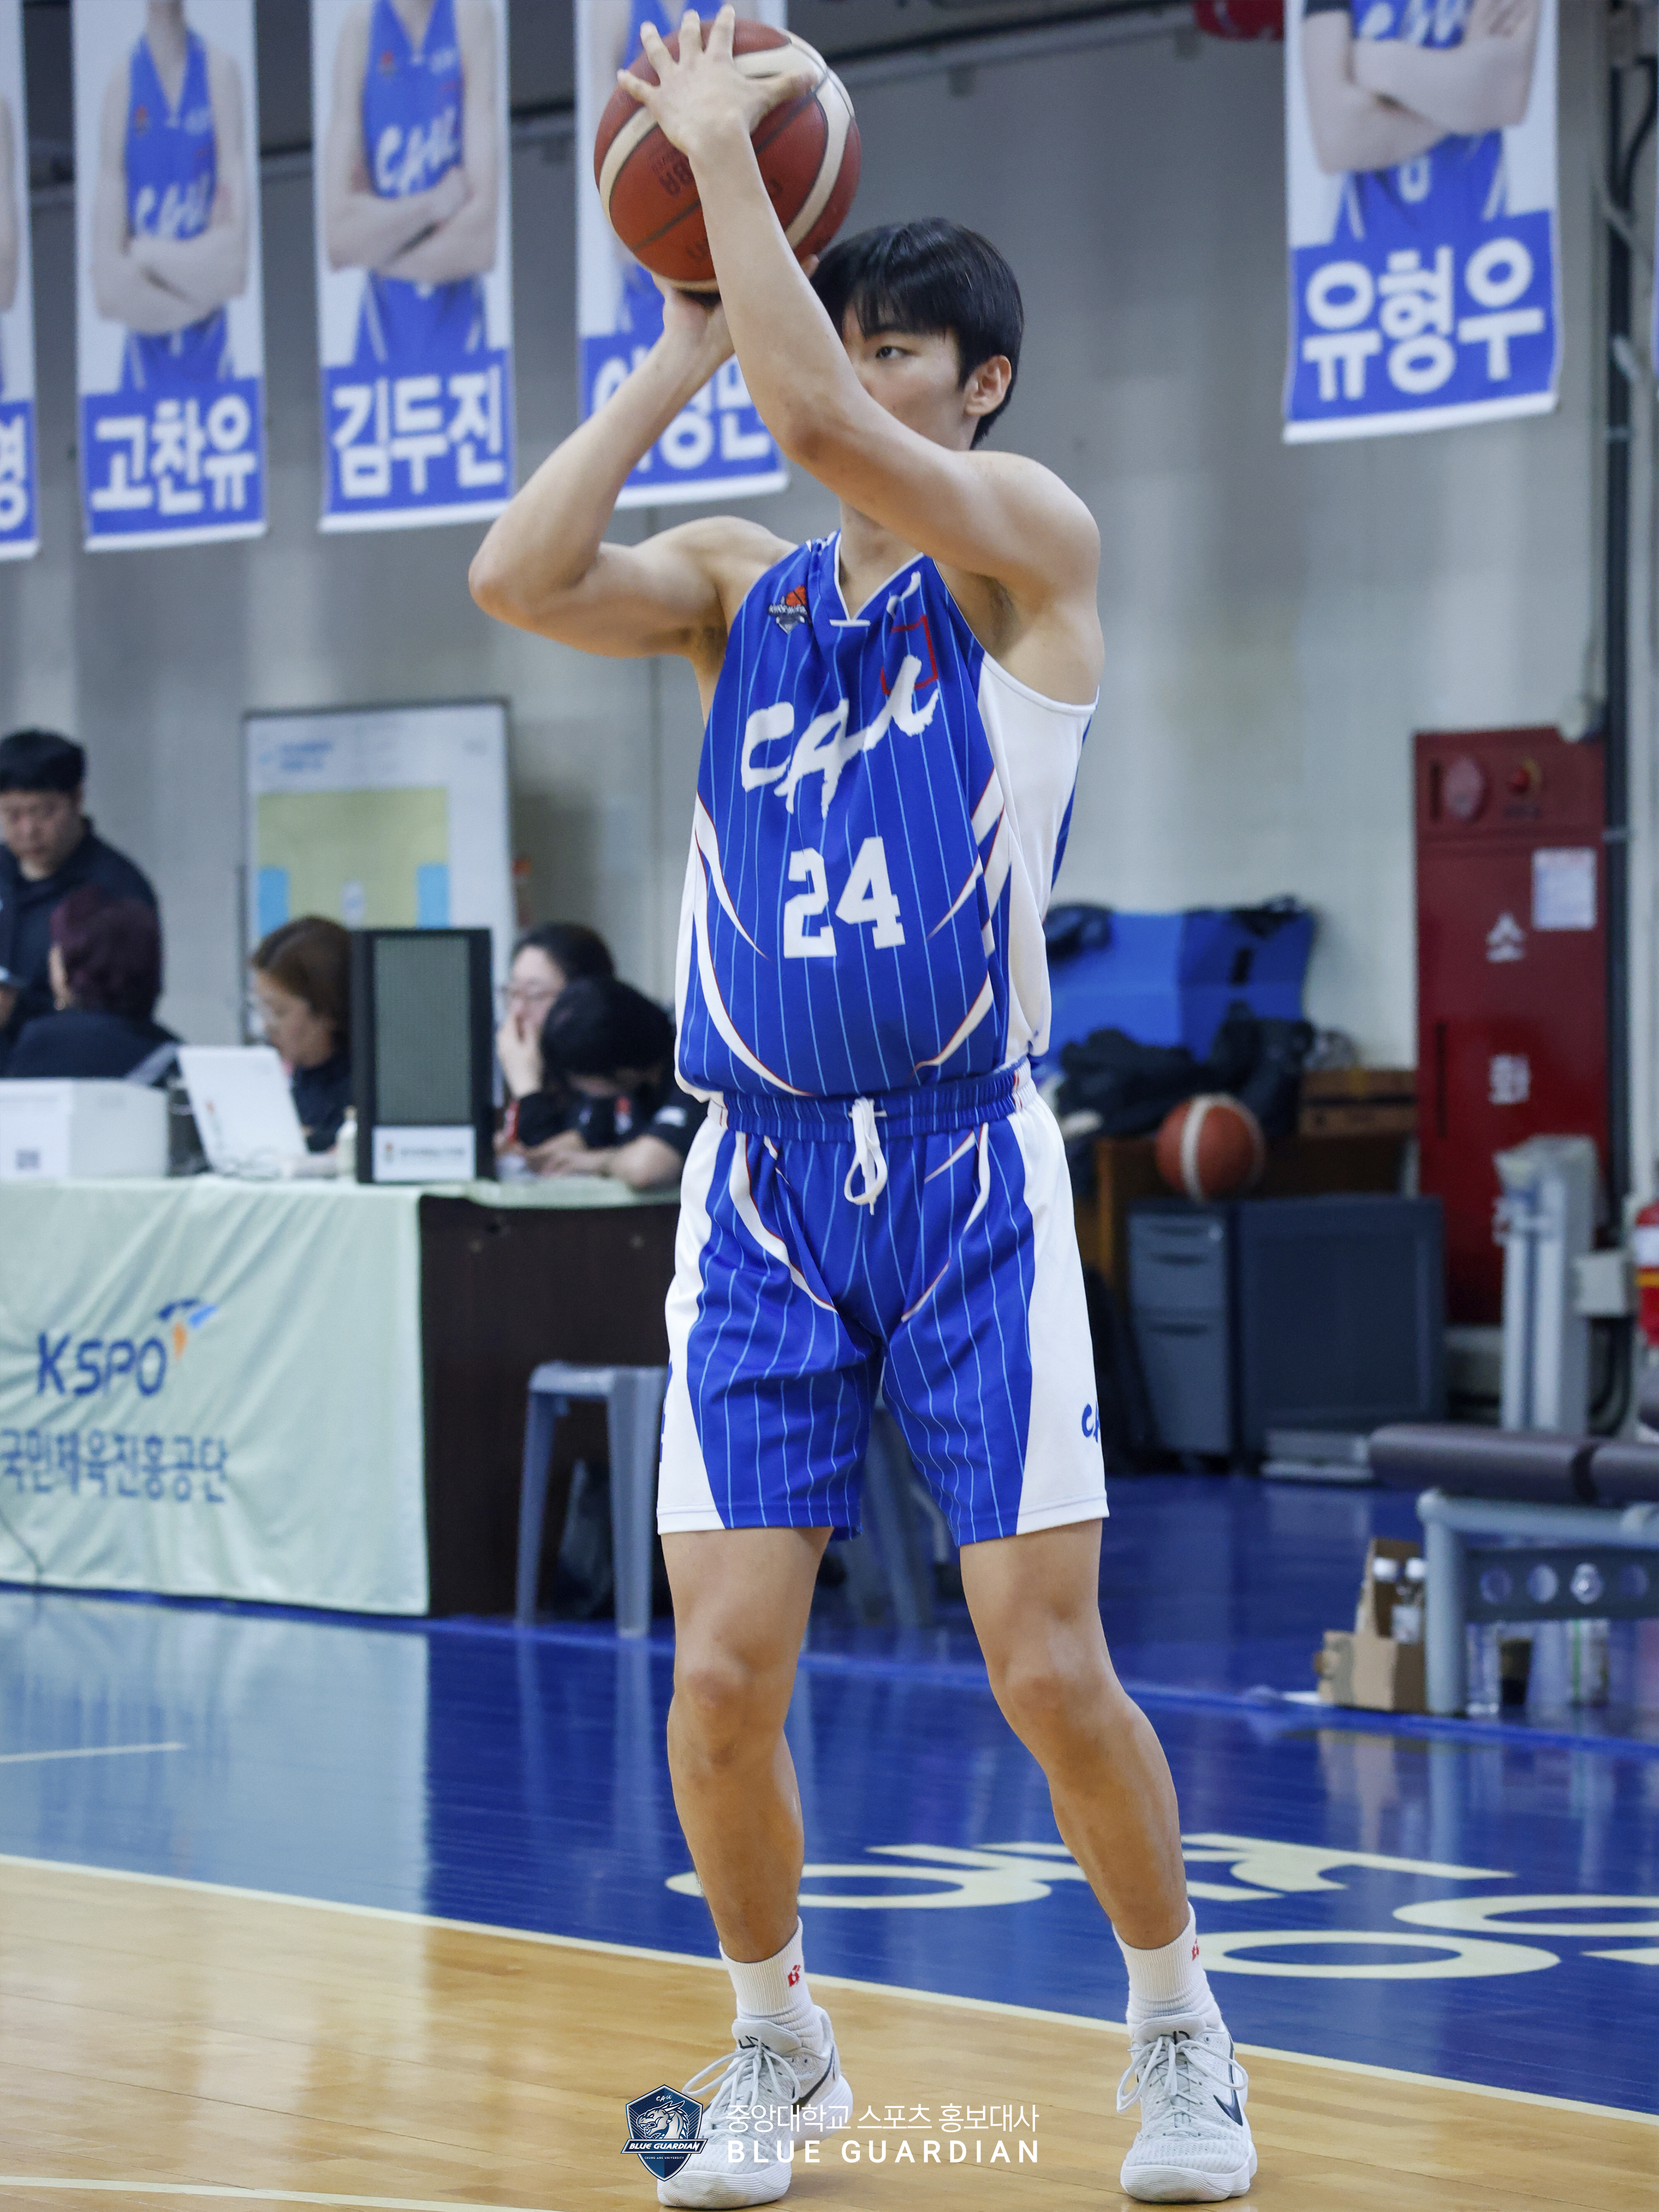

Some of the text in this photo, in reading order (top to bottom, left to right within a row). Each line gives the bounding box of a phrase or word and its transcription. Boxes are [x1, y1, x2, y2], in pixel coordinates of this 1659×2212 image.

[1302, 237, 1544, 401] 유형우
[91, 395, 257, 515] 고찬유
[332, 365, 505, 498] 김두진
[783, 836, 906, 958] 24
[36, 1330, 167, 1397] KSPO
[0, 1428, 228, 1502] 국민체육진흥공단
